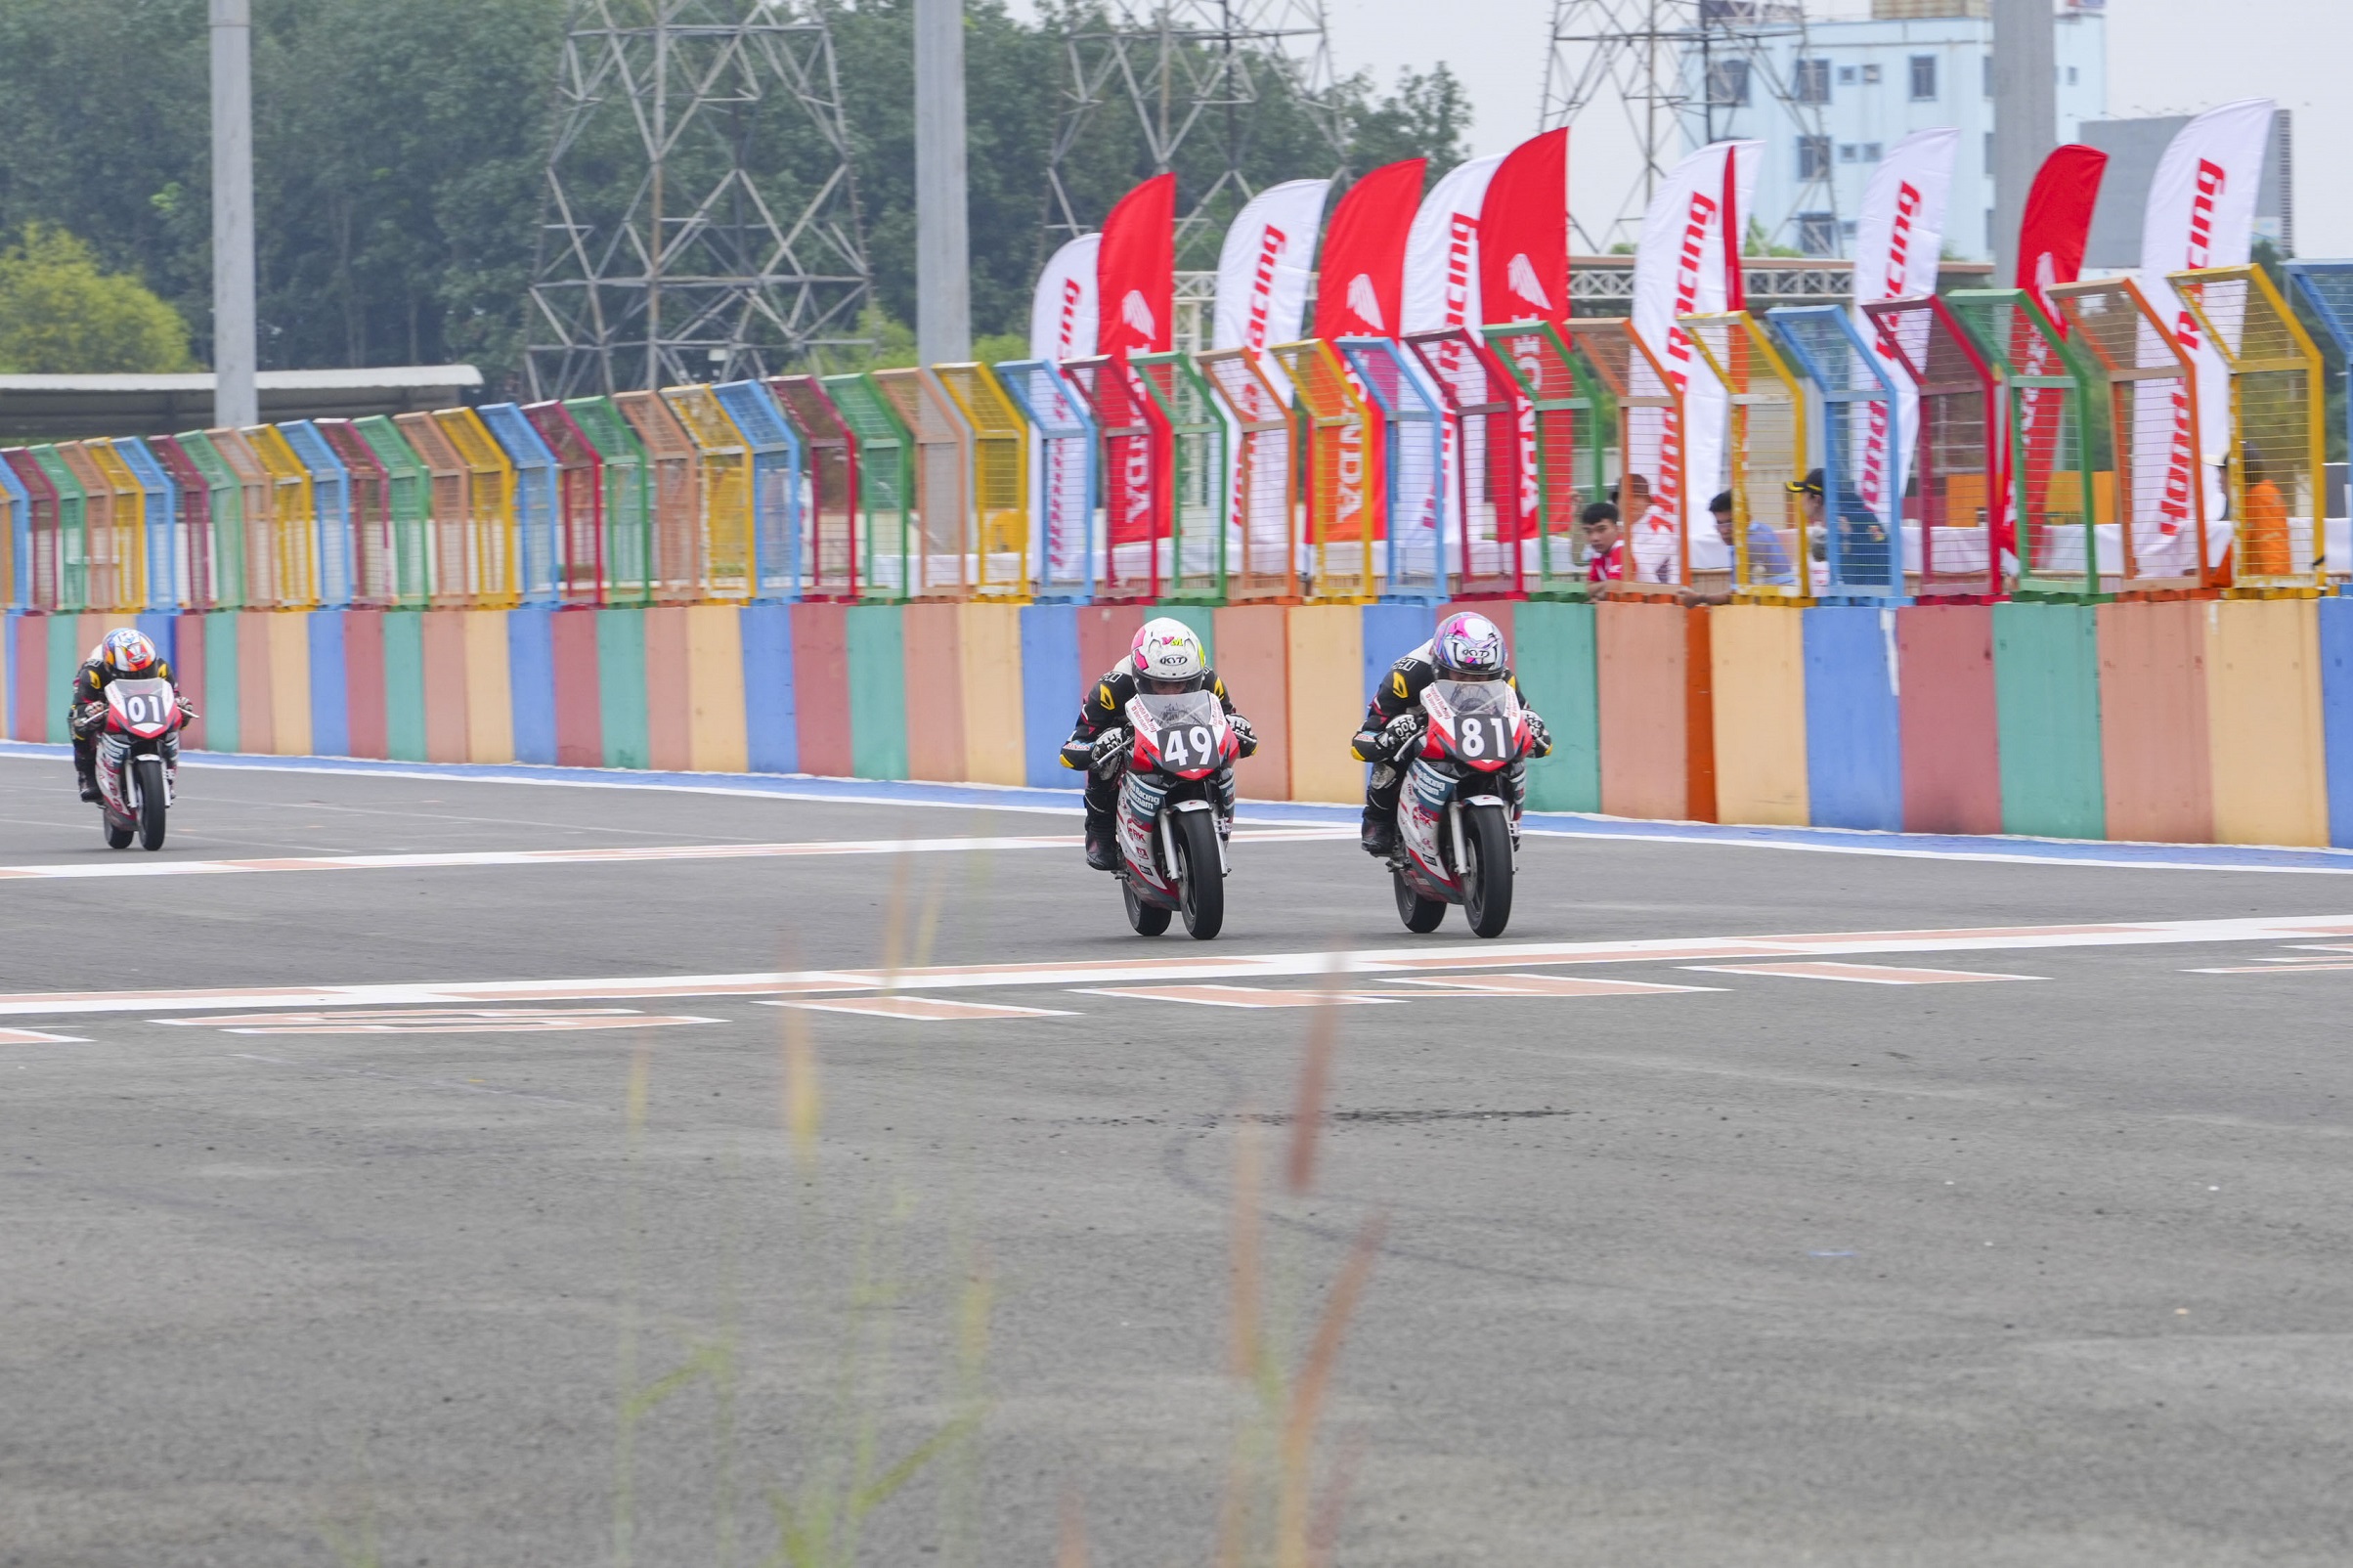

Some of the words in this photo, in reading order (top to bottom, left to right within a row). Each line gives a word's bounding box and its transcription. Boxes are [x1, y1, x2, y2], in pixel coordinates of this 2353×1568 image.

[1243, 224, 1287, 369] acing
[1667, 191, 1718, 365] Racing
[1512, 312, 1543, 518] HONDA
[1862, 375, 1894, 512] ond
[2159, 375, 2189, 537] Hond
[127, 695, 161, 722] 01
[1164, 725, 1213, 766] 49
[1460, 718, 1507, 759] 81
[1136, 786, 1160, 806] Racing
